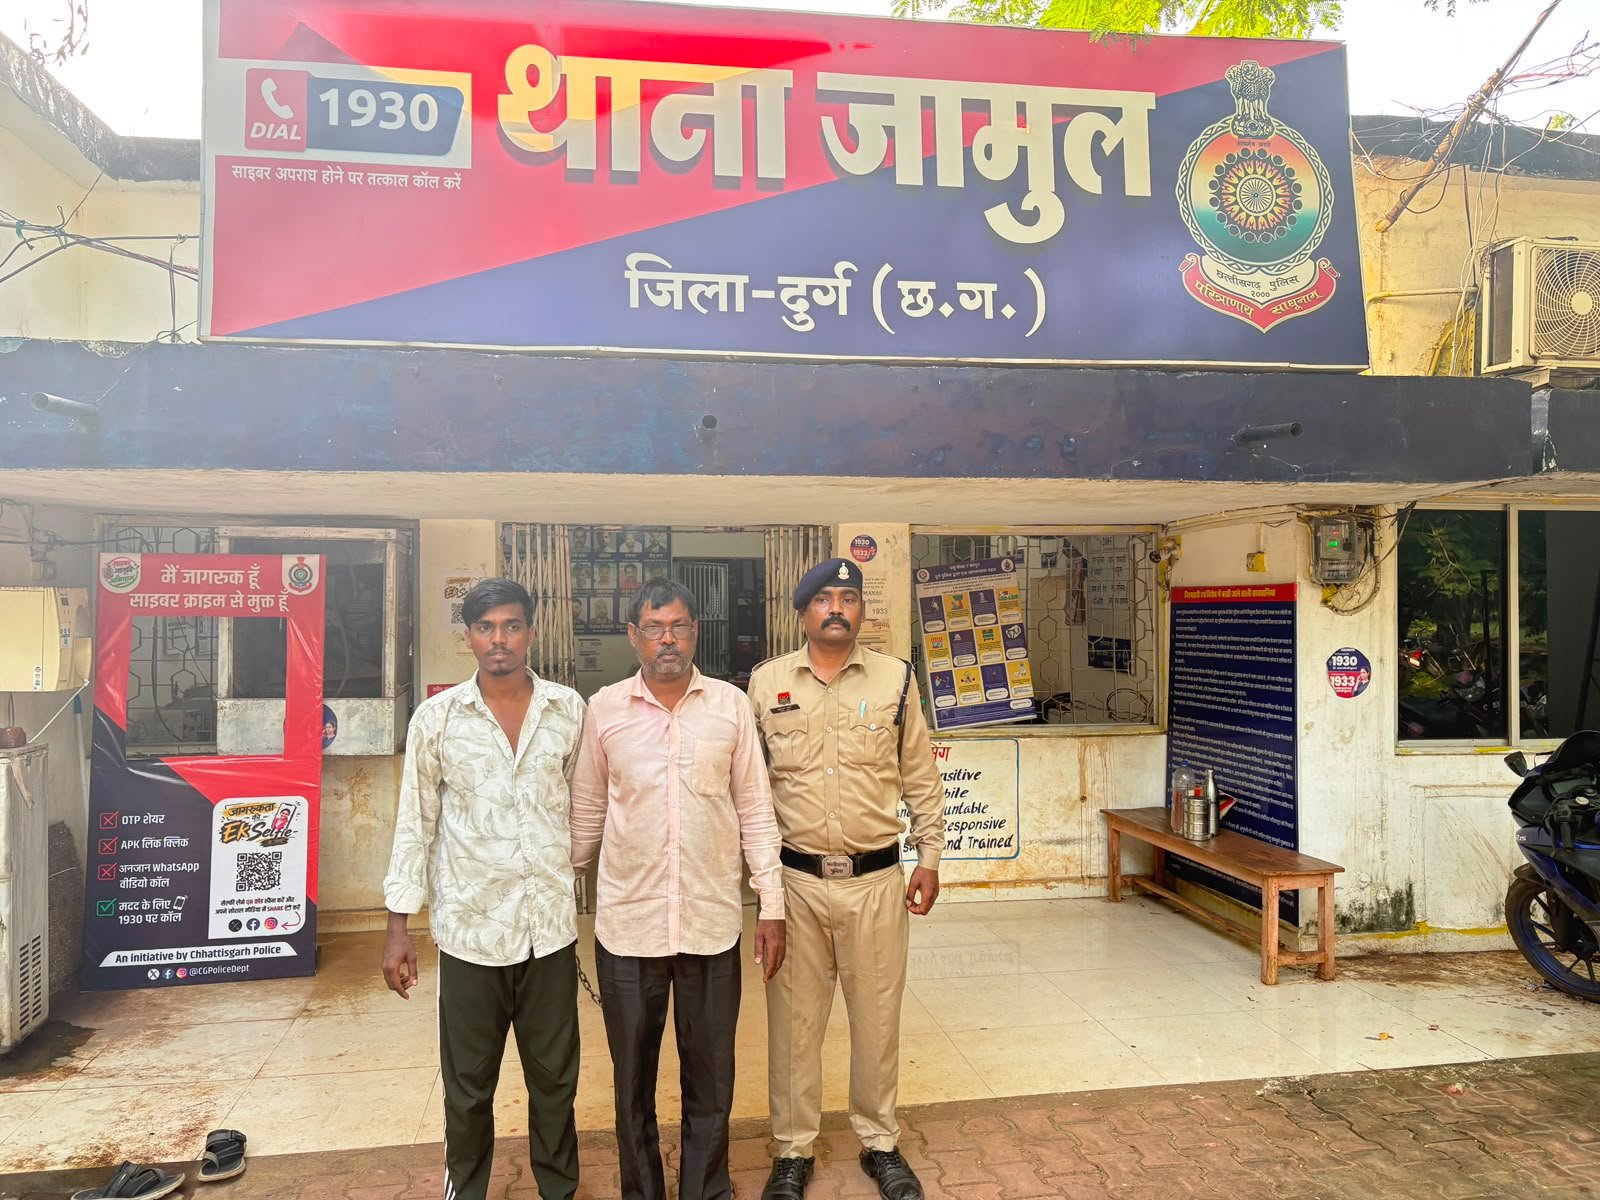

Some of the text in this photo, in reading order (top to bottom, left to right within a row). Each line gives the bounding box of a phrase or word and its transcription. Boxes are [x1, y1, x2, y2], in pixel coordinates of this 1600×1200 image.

[319, 88, 439, 132] 1930
[250, 122, 302, 141] DIAL
[498, 44, 1156, 244] थाना जामुल
[232, 165, 461, 190] साइबर अपराध होने पर तत्काल कॉल करें
[1270, 275, 1300, 291] पुलिस
[624, 252, 1046, 337] जिला-दुर्ग (छ.ग.)
[161, 564, 179, 584] मैं
[247, 563, 261, 589] हूँ
[129, 588, 290, 612] साइबर क्राइम से मुक्त हूँ
[1332, 655, 1358, 667] 1930
[1330, 675, 1355, 687] 1933
[940, 768, 982, 782] nsitive
[944, 786, 970, 799] bile
[944, 801, 989, 816] untable
[122, 812, 165, 824] OTP शेयर
[121, 835, 189, 849] APK लिंक क्लिक
[943, 833, 1014, 850] nd Trained
[119, 862, 200, 873] अनजान WhatsApp
[120, 876, 170, 889] वीडियो कॉल
[119, 898, 171, 911] मदद के लिए
[119, 911, 182, 925] 1930 पर कॉल
[115, 954, 128, 964] An
[176, 950, 188, 962] by
[190, 946, 251, 960] Chhattisgarh
[253, 945, 281, 956] Police
[189, 964, 250, 977] @CGPoliceDept
